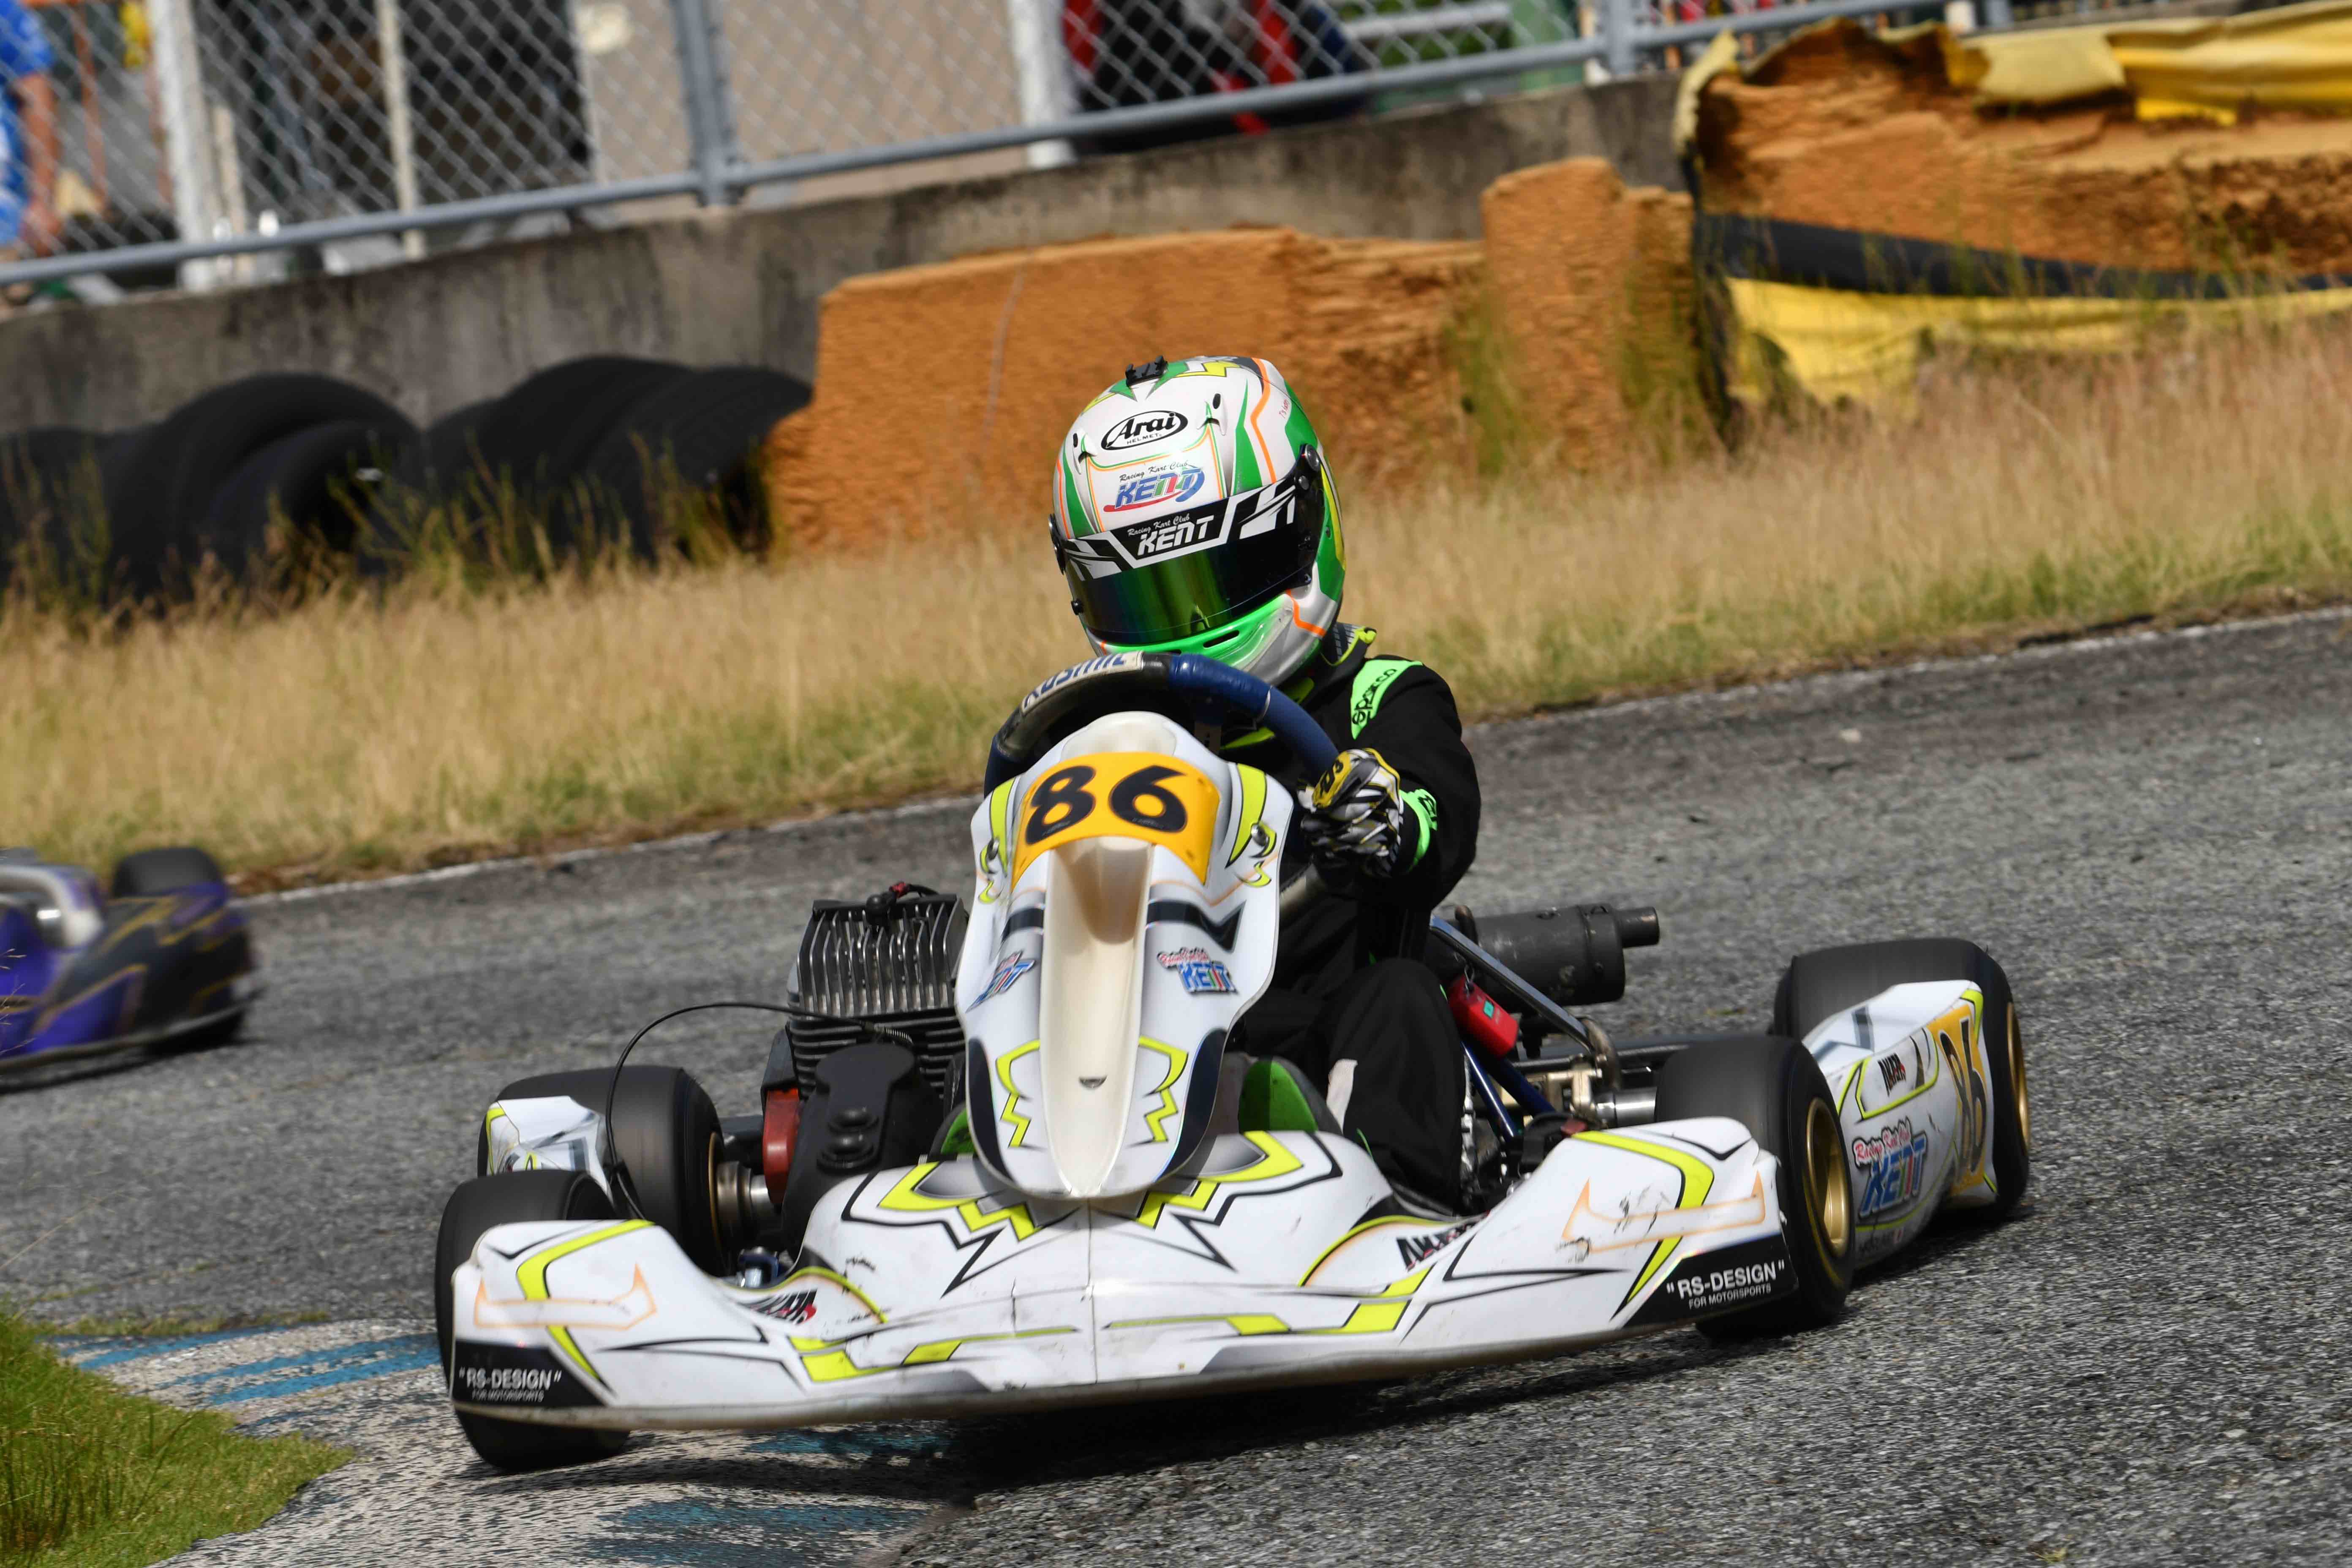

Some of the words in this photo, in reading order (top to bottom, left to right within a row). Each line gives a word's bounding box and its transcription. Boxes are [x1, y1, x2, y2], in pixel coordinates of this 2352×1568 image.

[1105, 412, 1177, 448] Arai
[1127, 433, 1159, 444] HELMET
[1119, 470, 1145, 482] Racing
[1148, 466, 1167, 474] Kart
[1169, 460, 1188, 470] Club
[1115, 468, 1203, 509] KENT
[1127, 526, 1151, 536] Racing
[1153, 520, 1171, 529] Kart
[1173, 513, 1190, 525] Club
[1137, 515, 1214, 556] KENT
[1026, 765, 1187, 845] 86
[1689, 1296, 1707, 1309] FOR
[1709, 1283, 1771, 1304] MOTORSPORTS
